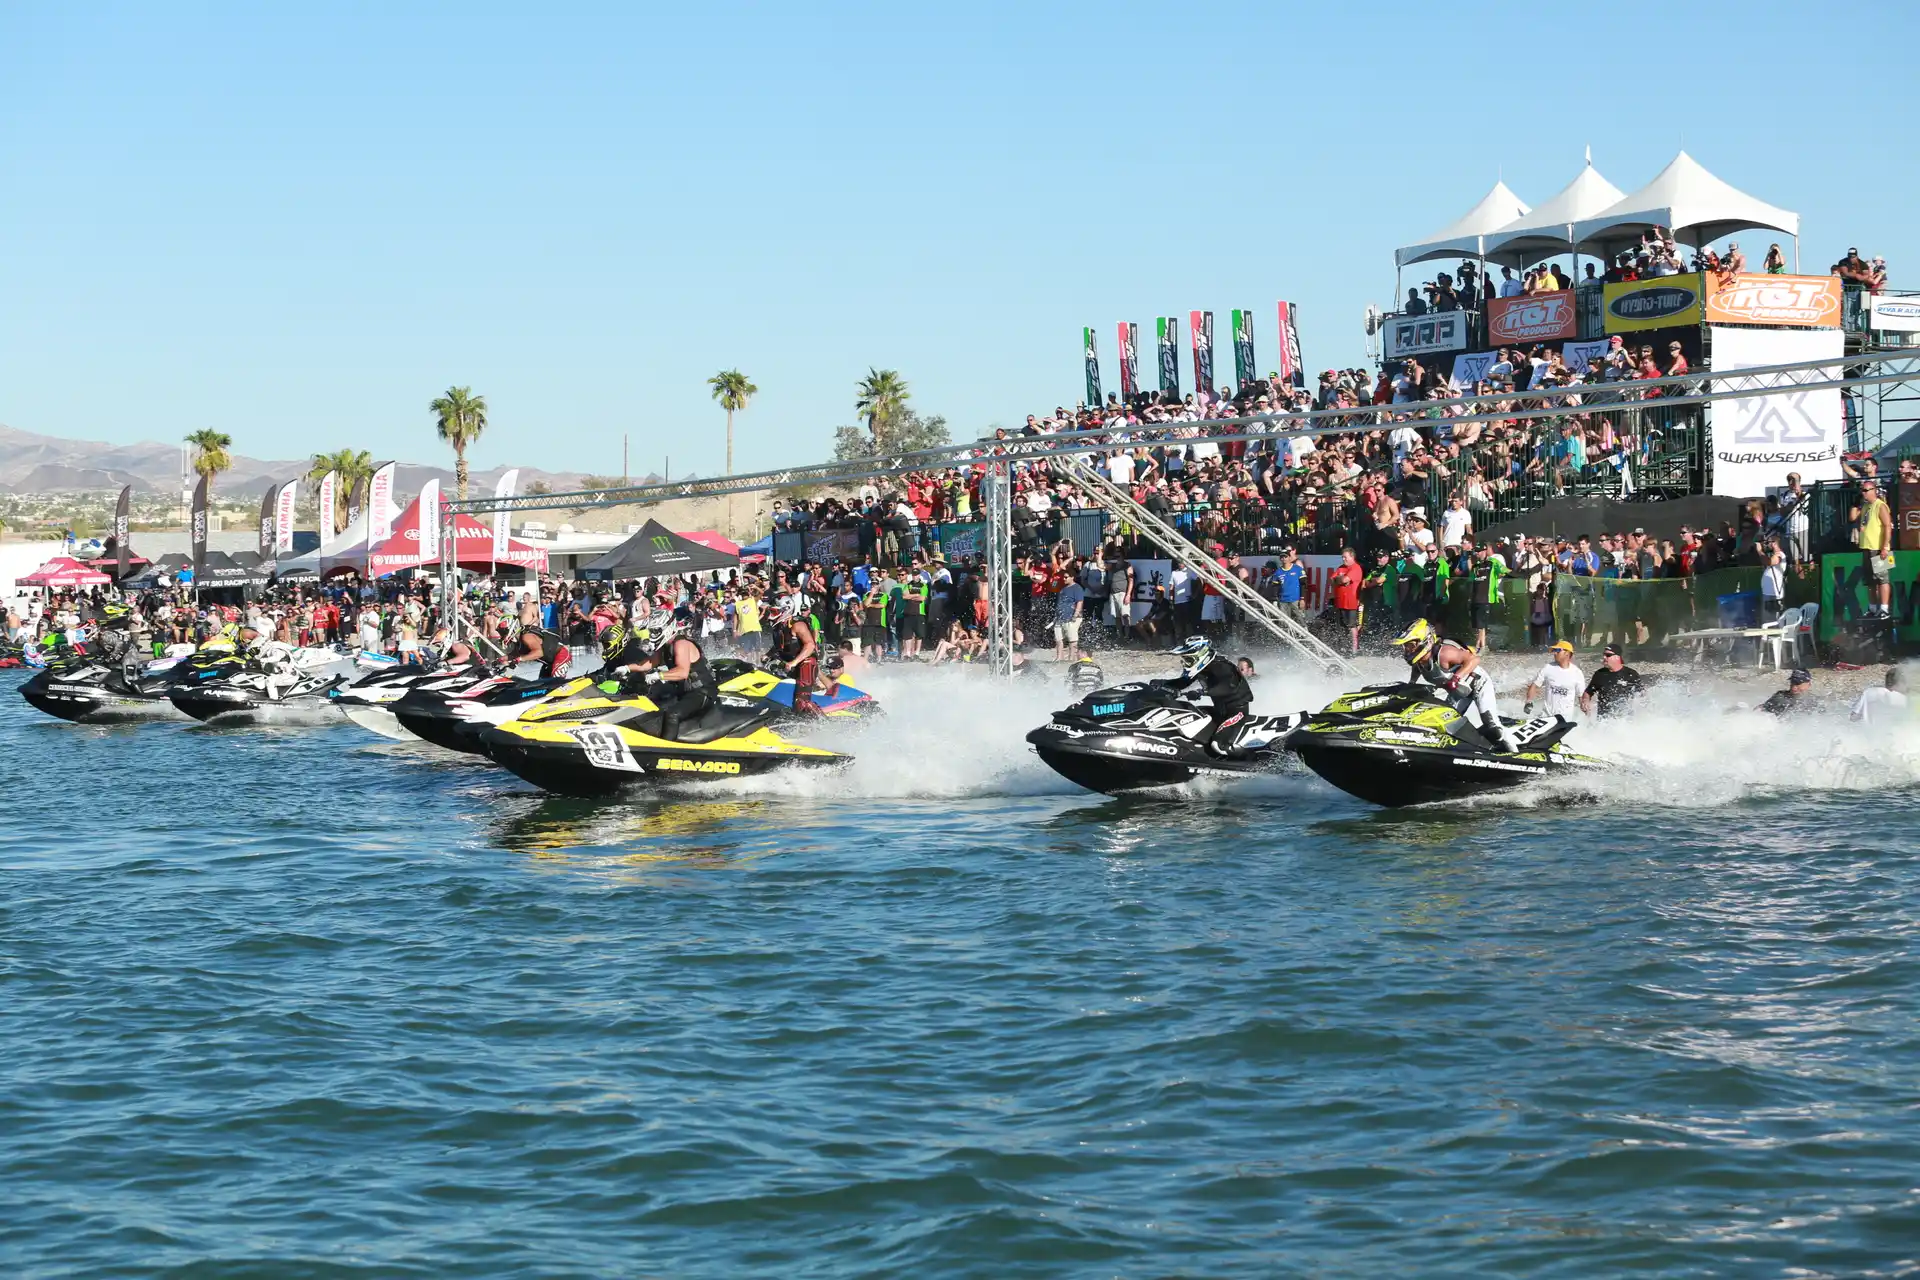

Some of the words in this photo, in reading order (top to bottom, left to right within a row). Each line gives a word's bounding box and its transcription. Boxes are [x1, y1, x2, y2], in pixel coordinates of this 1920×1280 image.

[1517, 324, 1562, 338] PRODUCTS
[280, 491, 292, 535] YAMAHA
[383, 555, 420, 565] YAMAHA
[211, 579, 223, 587] SKI
[1511, 718, 1549, 743] 158
